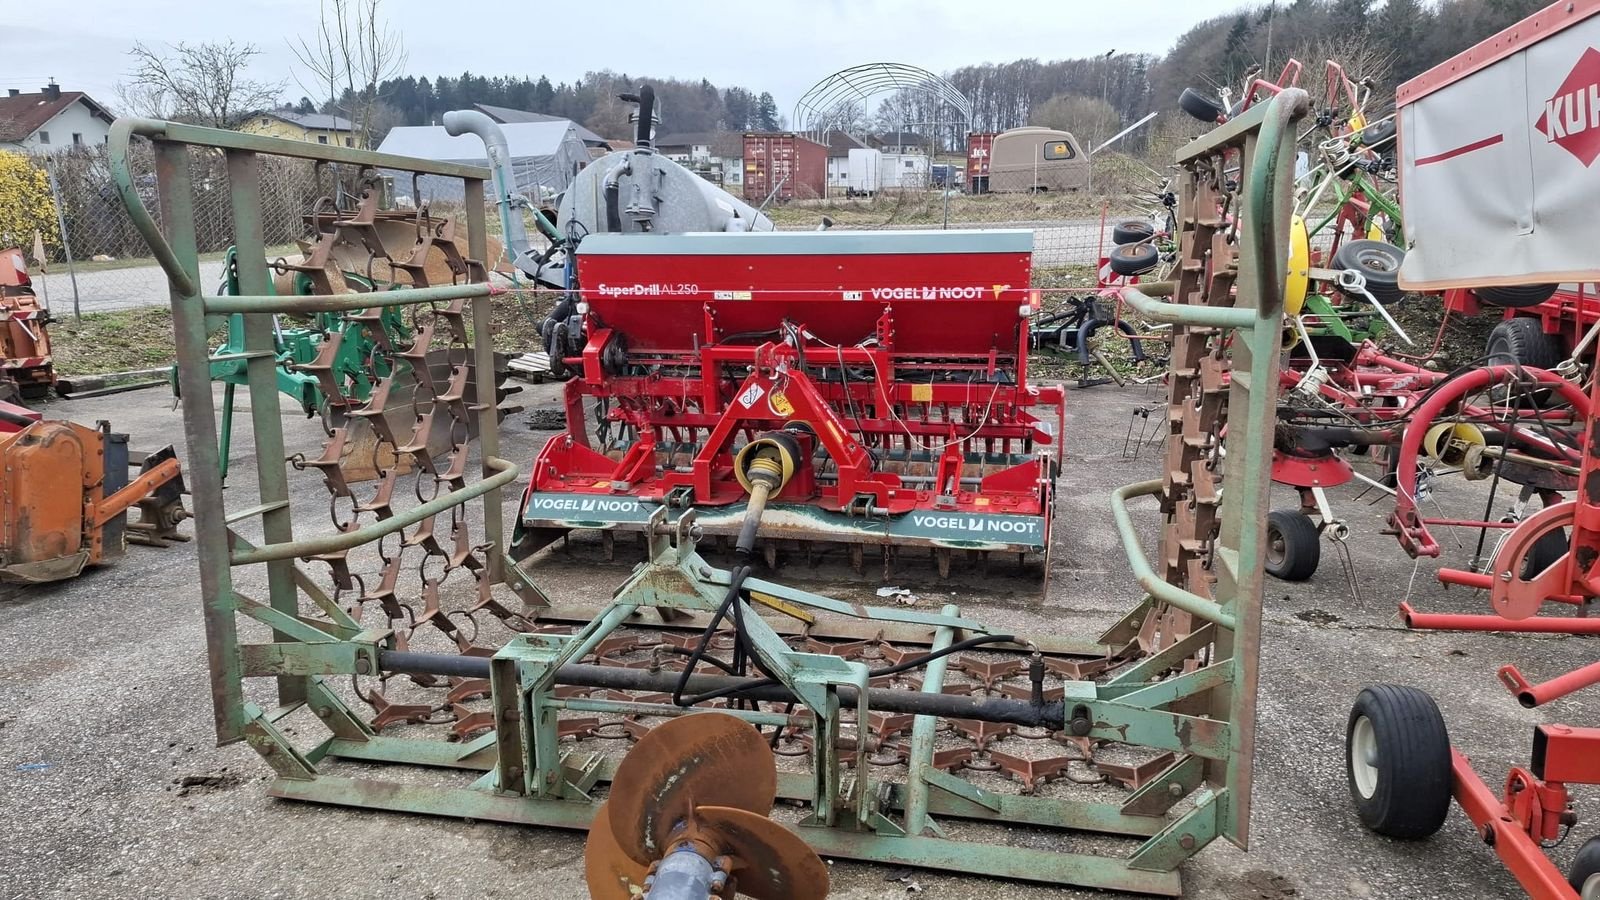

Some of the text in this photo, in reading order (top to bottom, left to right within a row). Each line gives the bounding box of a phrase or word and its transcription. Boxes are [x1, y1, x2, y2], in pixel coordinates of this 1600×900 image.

[871, 287, 984, 299] VOGEL NOOT
[534, 499, 639, 512] VOGEL NOOT
[913, 516, 1036, 533] VOGEL NOOT
